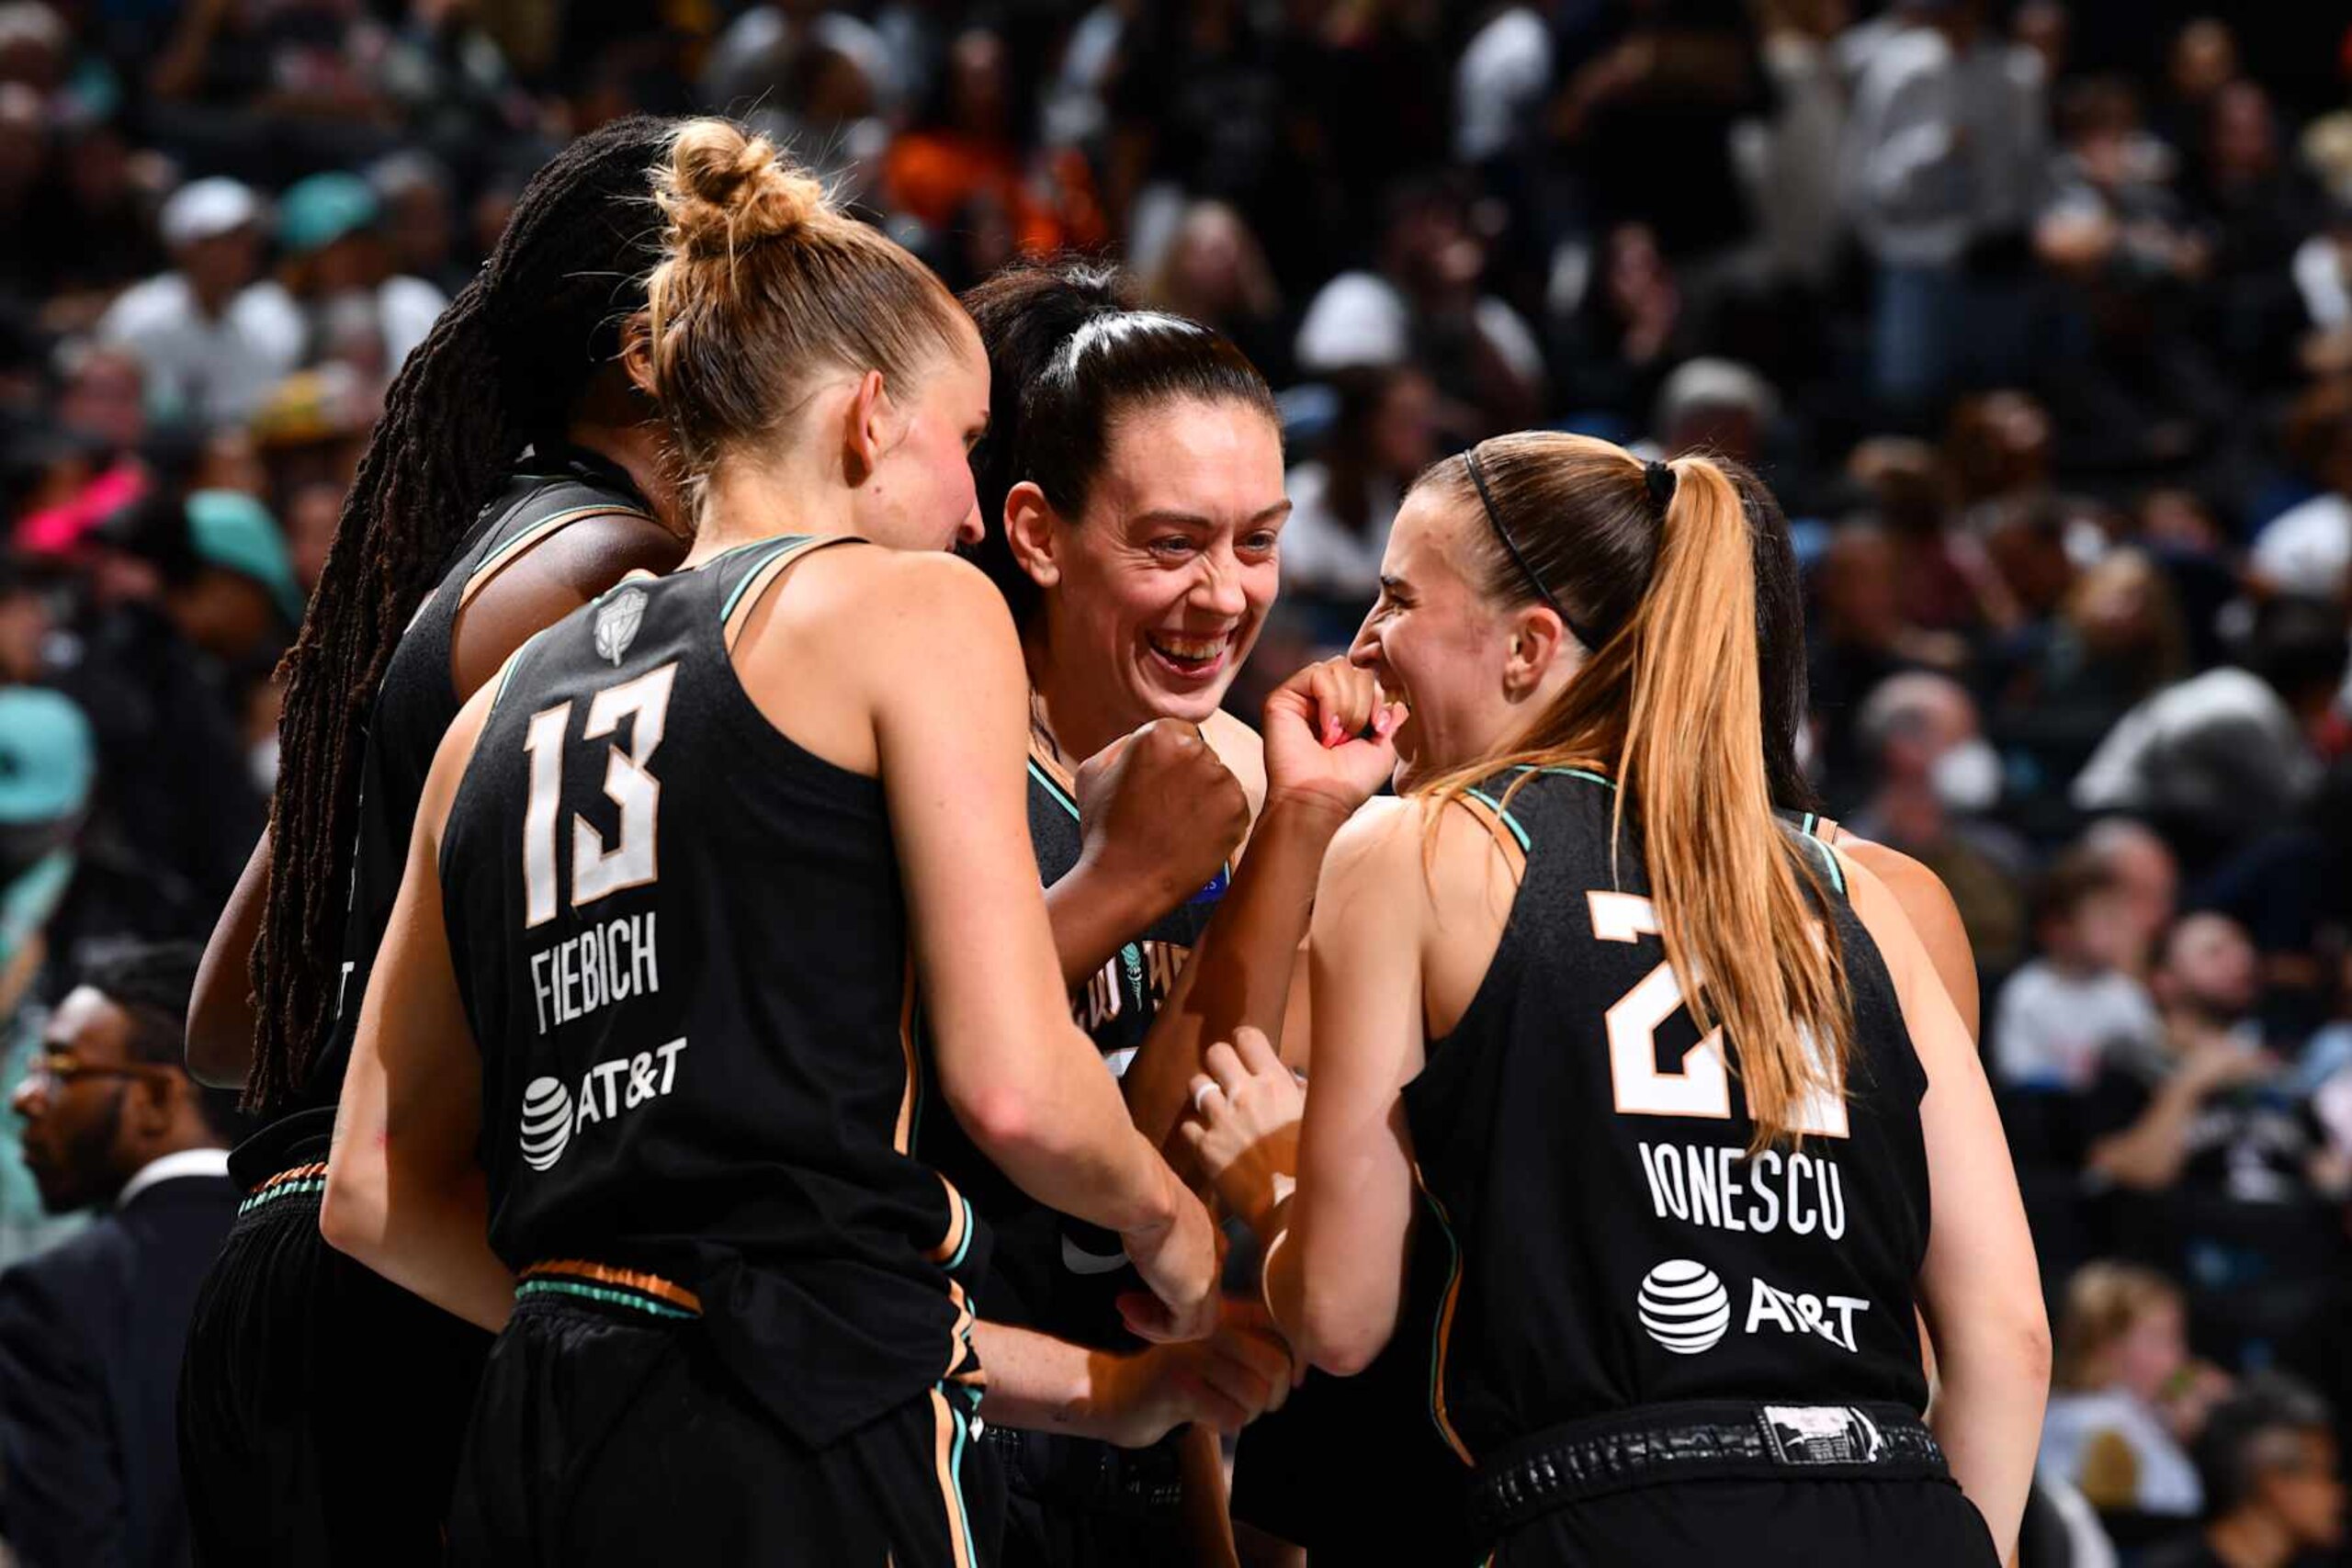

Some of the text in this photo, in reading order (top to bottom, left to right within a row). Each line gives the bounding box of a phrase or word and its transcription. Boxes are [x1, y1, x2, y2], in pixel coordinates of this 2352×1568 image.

[523, 660, 679, 930] 13
[530, 911, 660, 1035] FIEBICH
[575, 1035, 688, 1135] AT&T
[1638, 1141, 1847, 1241] IONESCU
